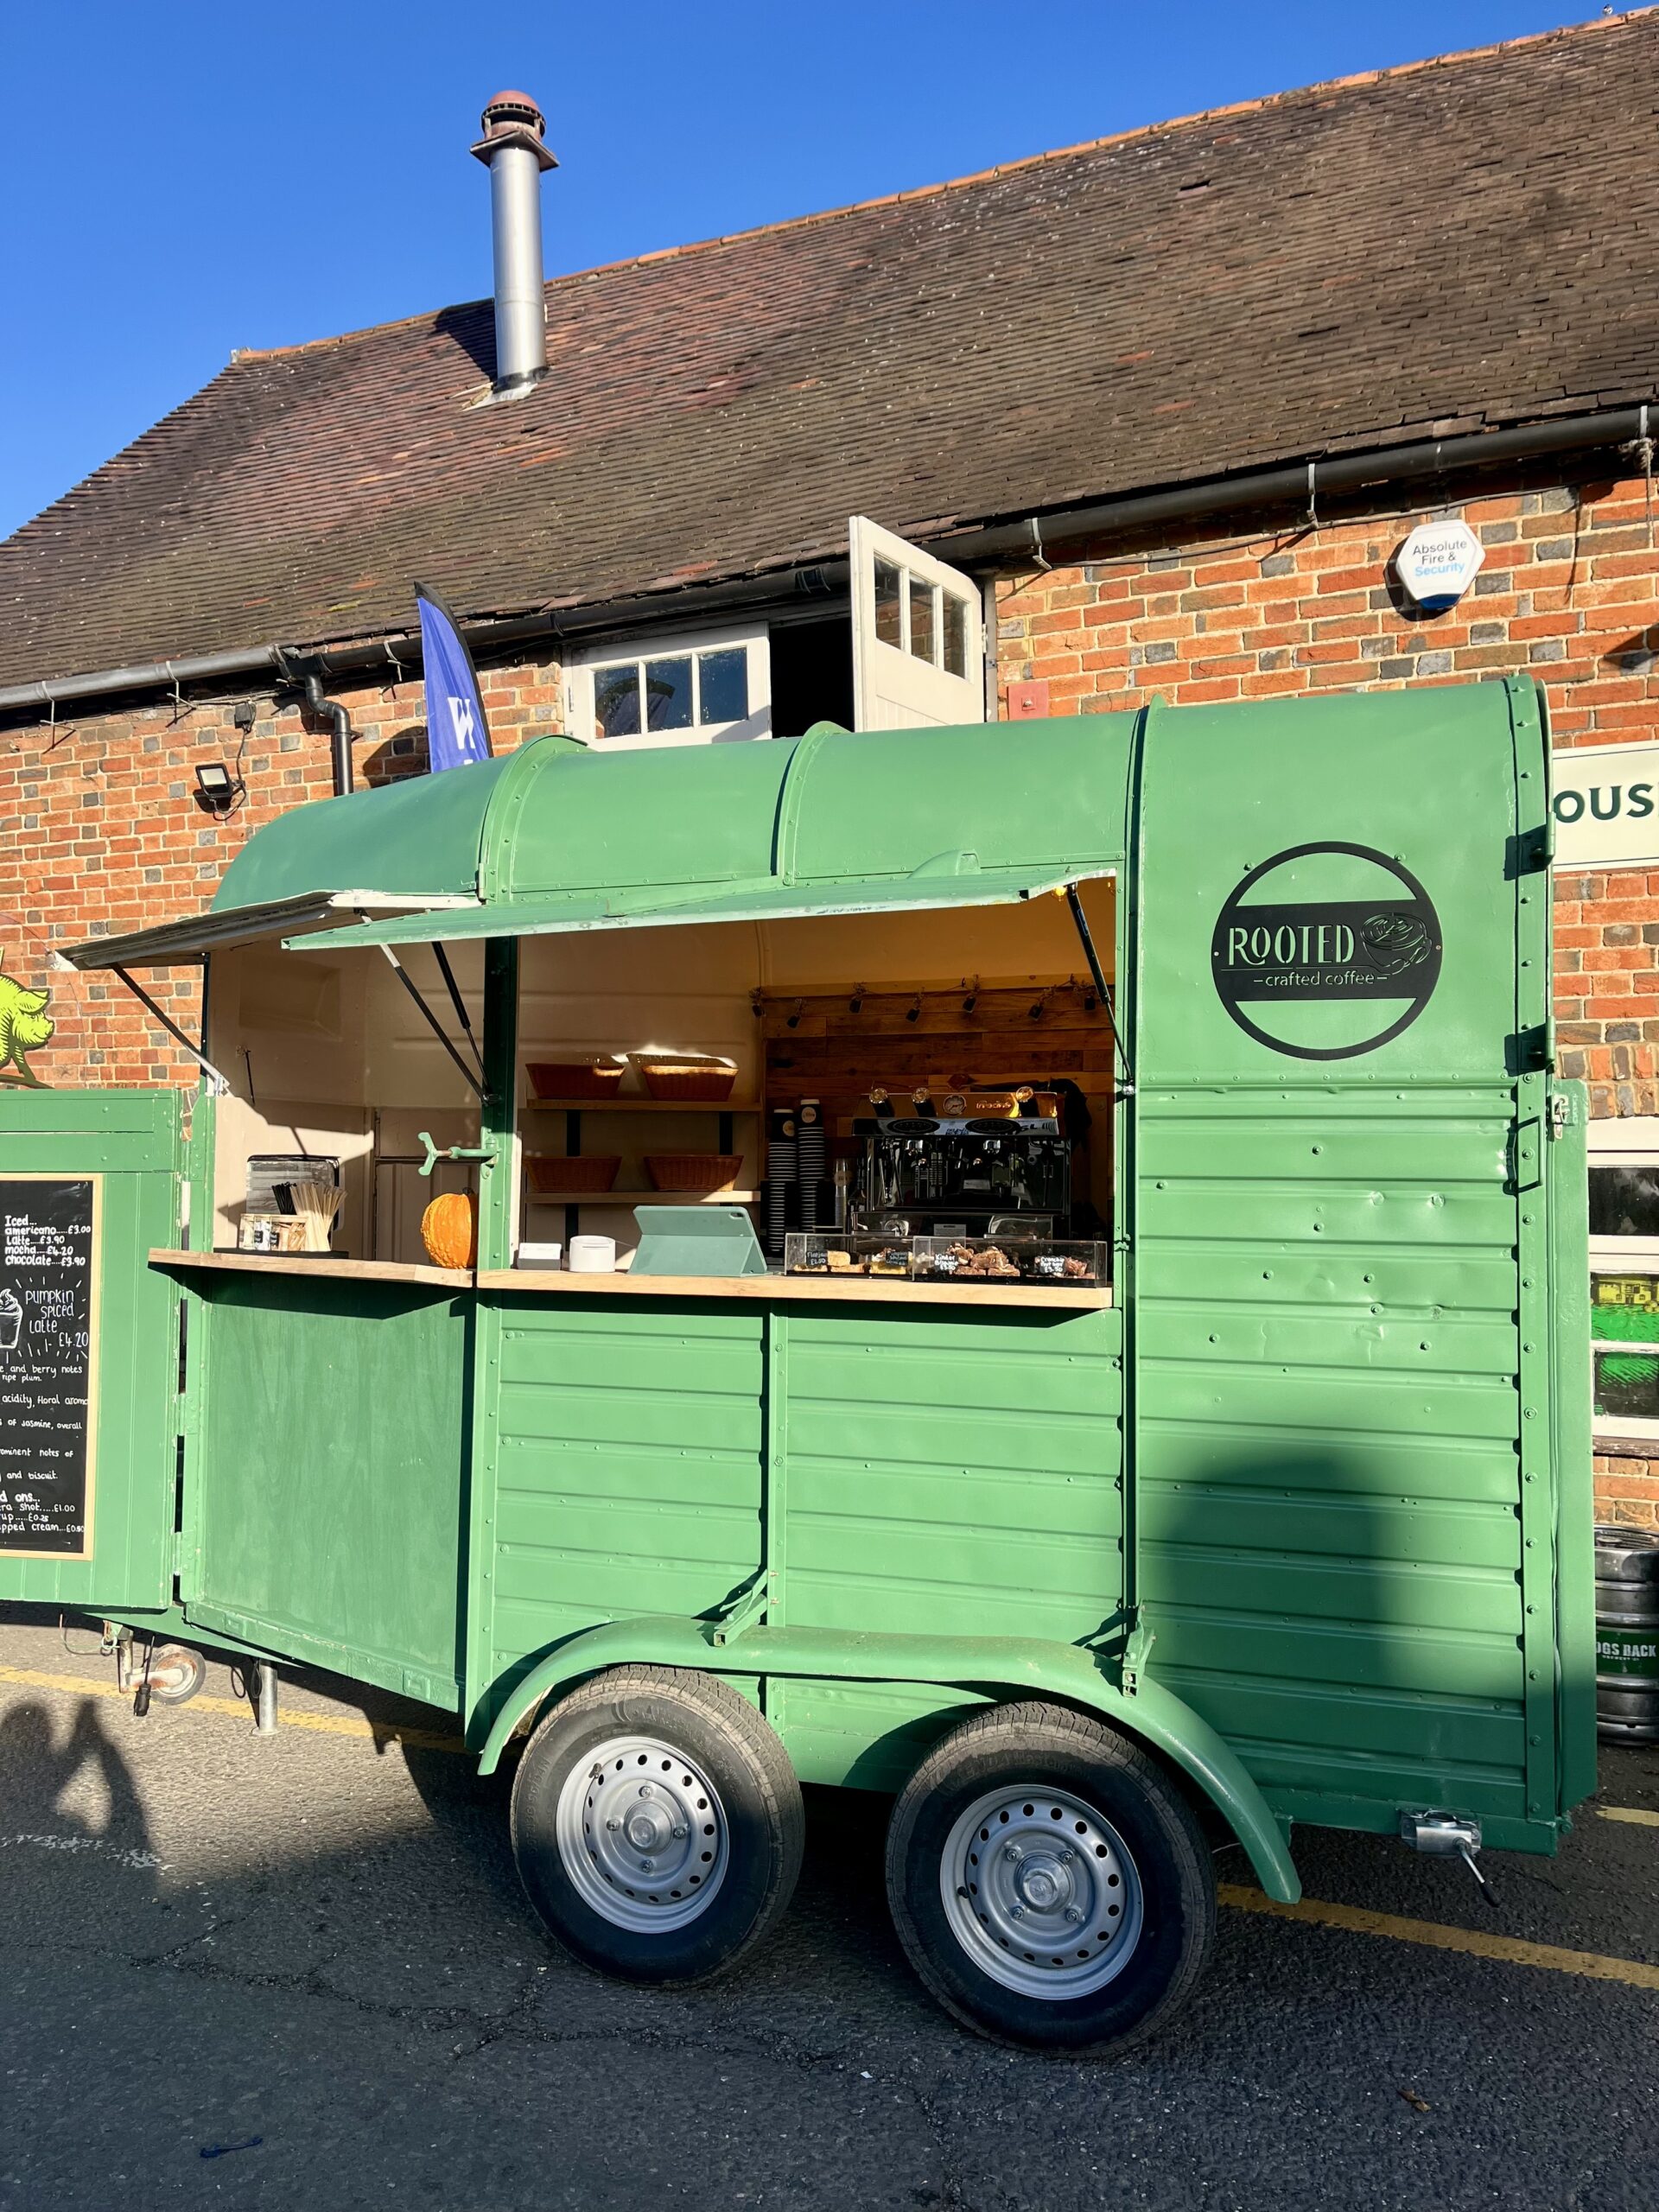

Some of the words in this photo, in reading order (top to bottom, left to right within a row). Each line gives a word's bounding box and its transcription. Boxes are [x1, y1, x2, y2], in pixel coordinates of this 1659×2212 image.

[1413, 540, 1467, 555] Absolute
[1421, 555, 1445, 564] Fire
[1448, 552, 1455, 561] &
[1414, 563, 1465, 577] Security
[1554, 783, 1659, 823] OUS
[1228, 925, 1355, 965] ROOTED
[1325, 970, 1375, 985] coffee
[67, 1225, 92, 1234] £3.00
[40, 1236, 65, 1244] £3.90
[61, 1257, 86, 1267] £3.90
[59, 1332, 89, 1347] £4.20
[10, 1364, 27, 1373] and
[32, 1364, 57, 1378] berry
[2, 1374, 16, 1383] ripe
[40, 1448, 60, 1457] notes
[7, 1470, 22, 1479] and
[0, 1503, 13, 1511] ra
[54, 1503, 76, 1512] £1.00
[0, 1513, 14, 1523] up
[0, 1521, 25, 1534] pped
[1623, 1644, 1656, 1657] BACK
